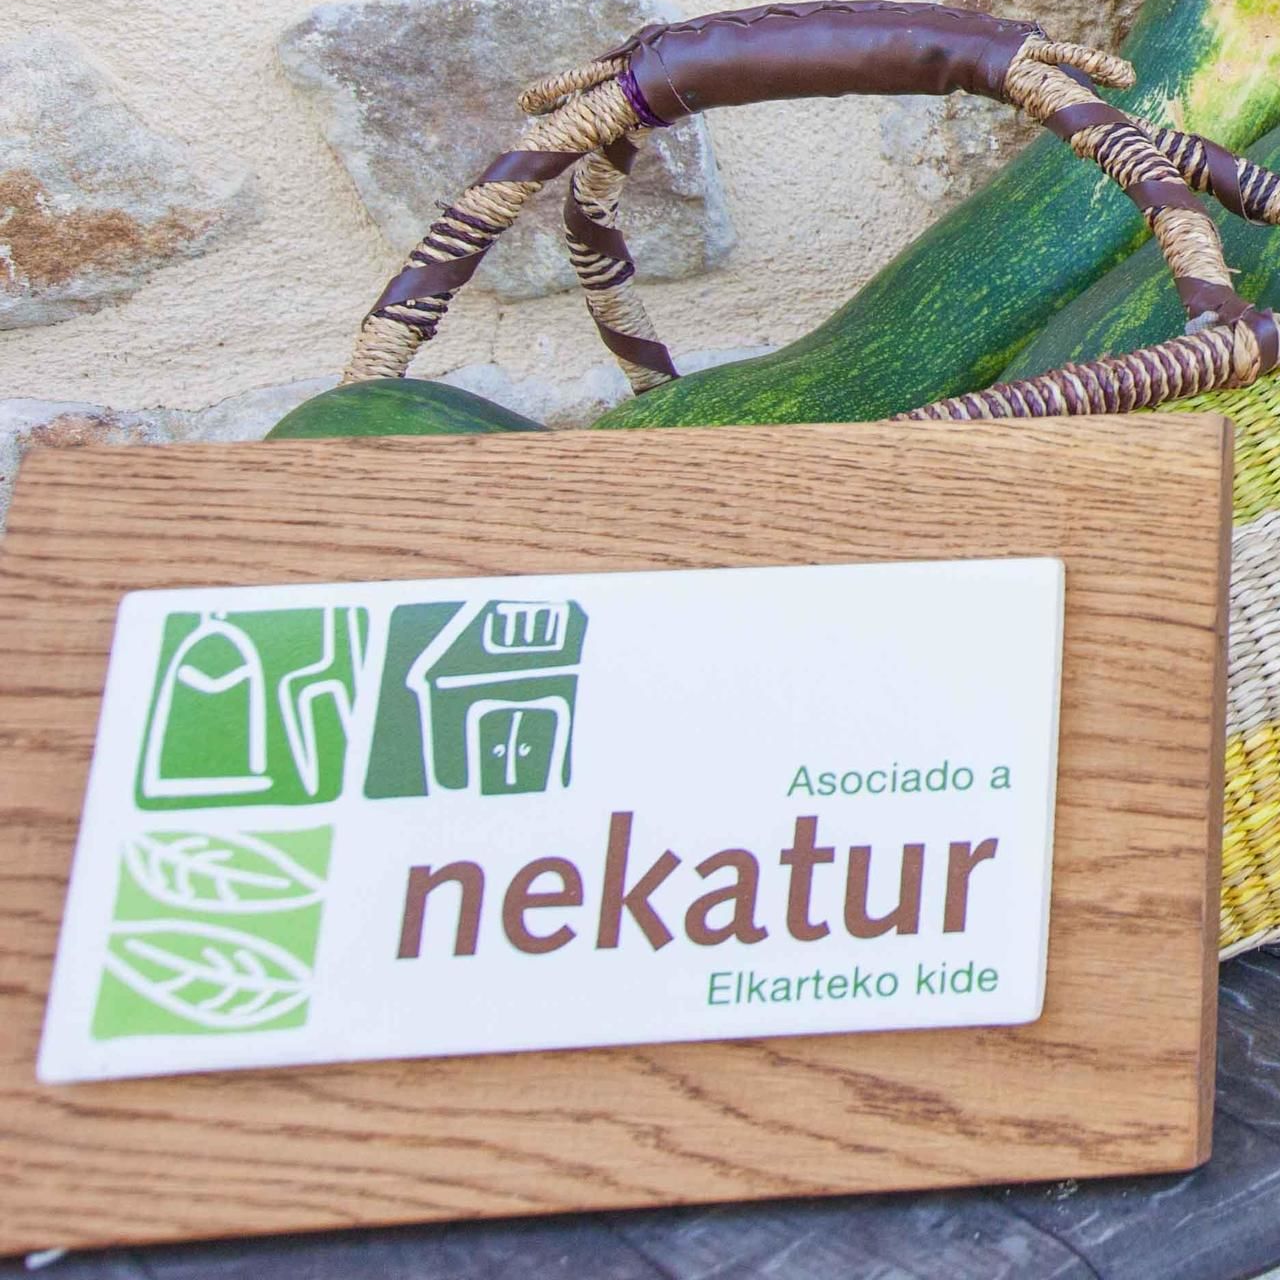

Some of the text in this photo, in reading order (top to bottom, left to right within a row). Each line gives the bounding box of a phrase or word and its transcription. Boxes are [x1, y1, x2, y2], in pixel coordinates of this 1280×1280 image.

[786, 759, 1012, 798] Asociado a
[396, 811, 999, 960] nekatur
[706, 960, 1000, 1006] Elkarteko kide
